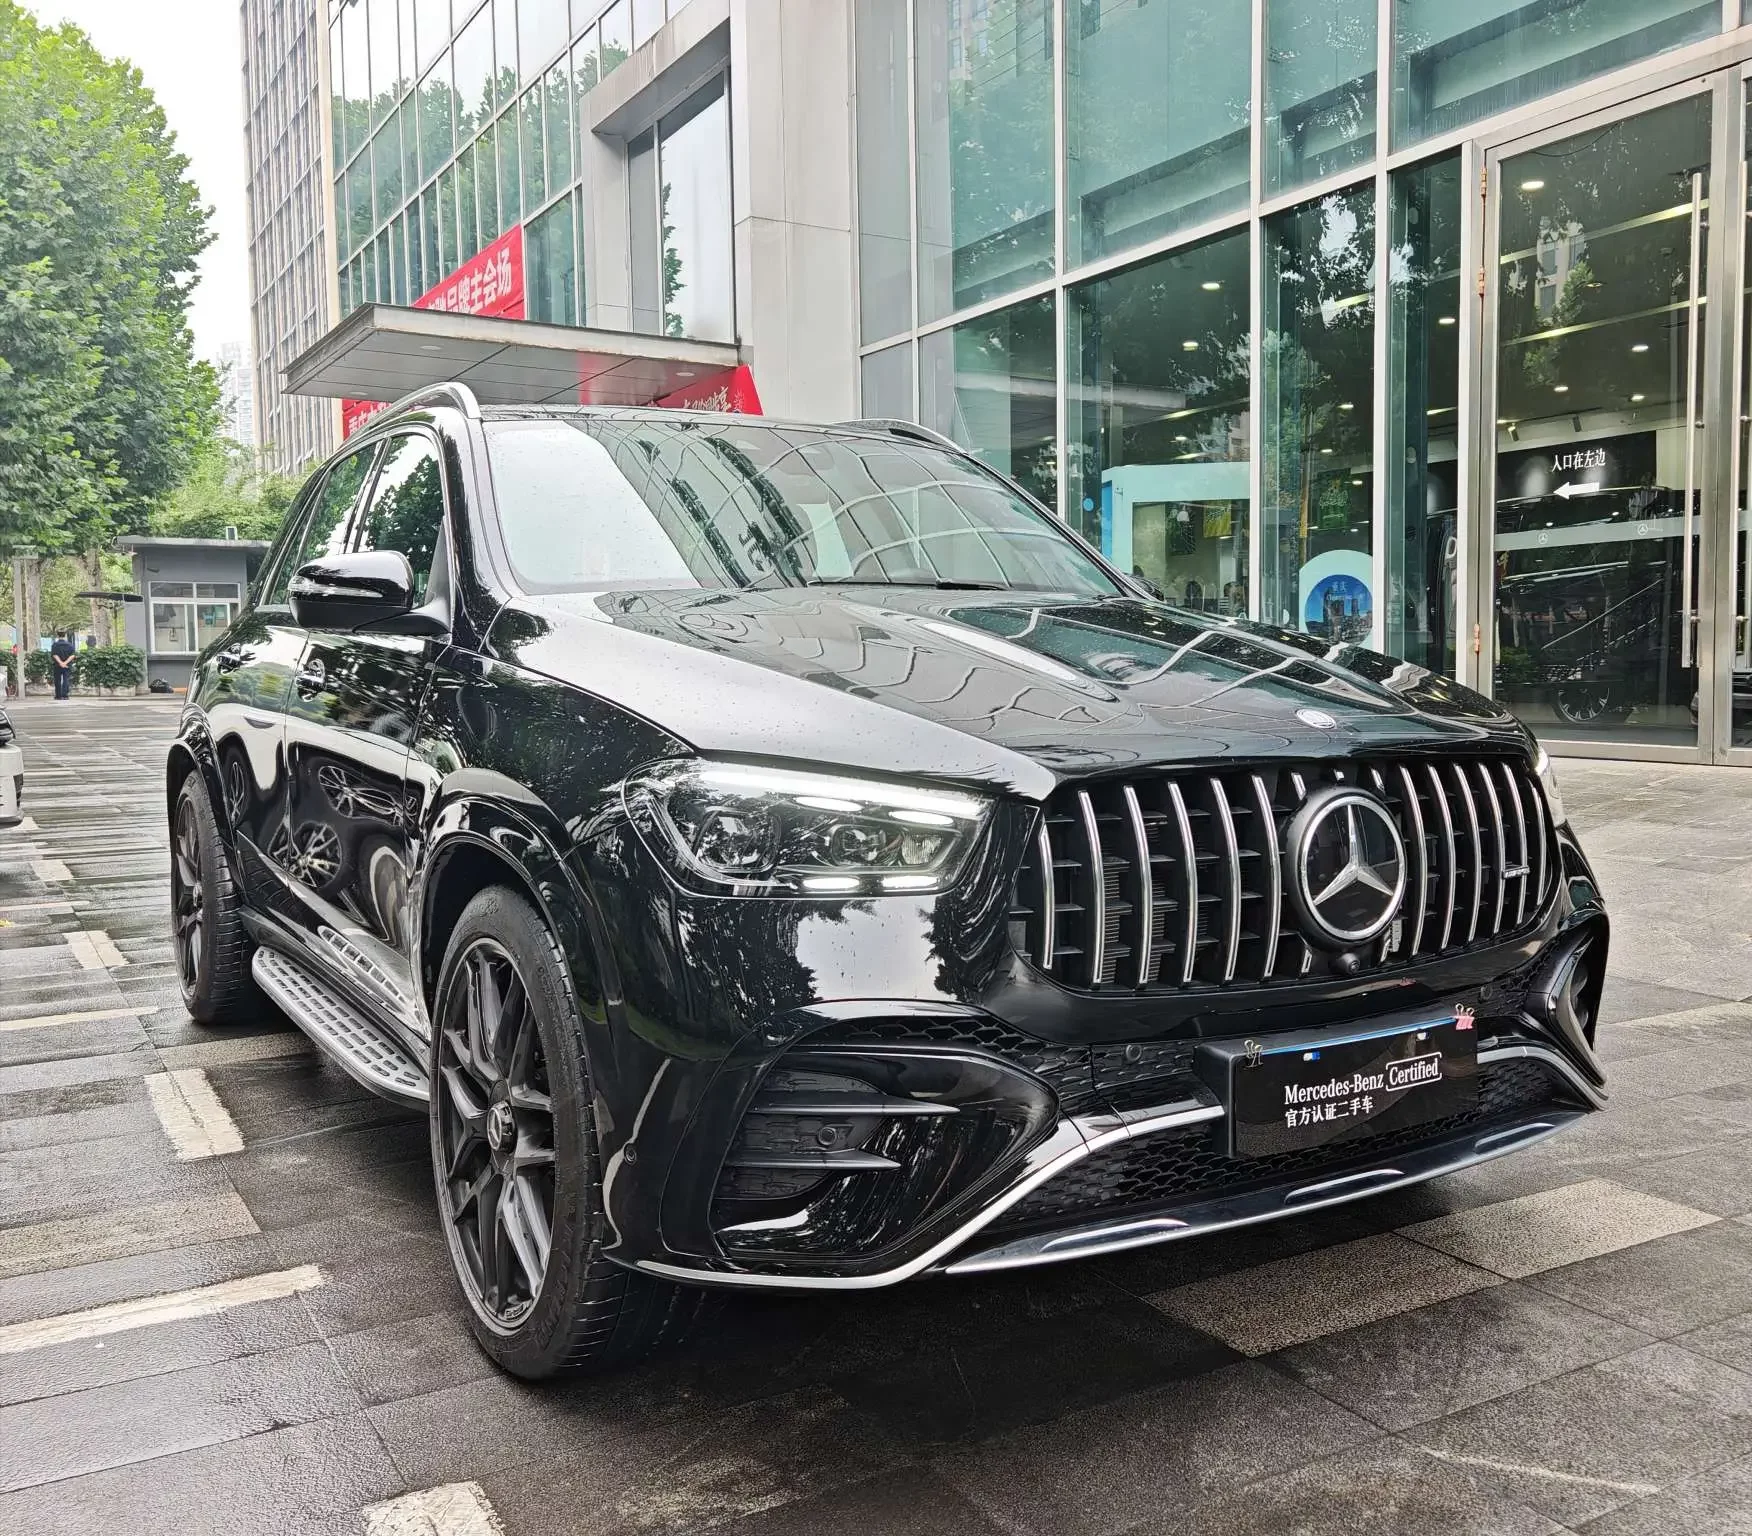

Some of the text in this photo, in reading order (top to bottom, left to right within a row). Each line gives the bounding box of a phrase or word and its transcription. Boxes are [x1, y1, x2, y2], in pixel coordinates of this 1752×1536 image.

[1551, 447, 1606, 473] 入口在左边
[1284, 1057, 1439, 1105] Mercedes-Benz Certified
[1285, 1095, 1374, 1129] 官方认证二手车
